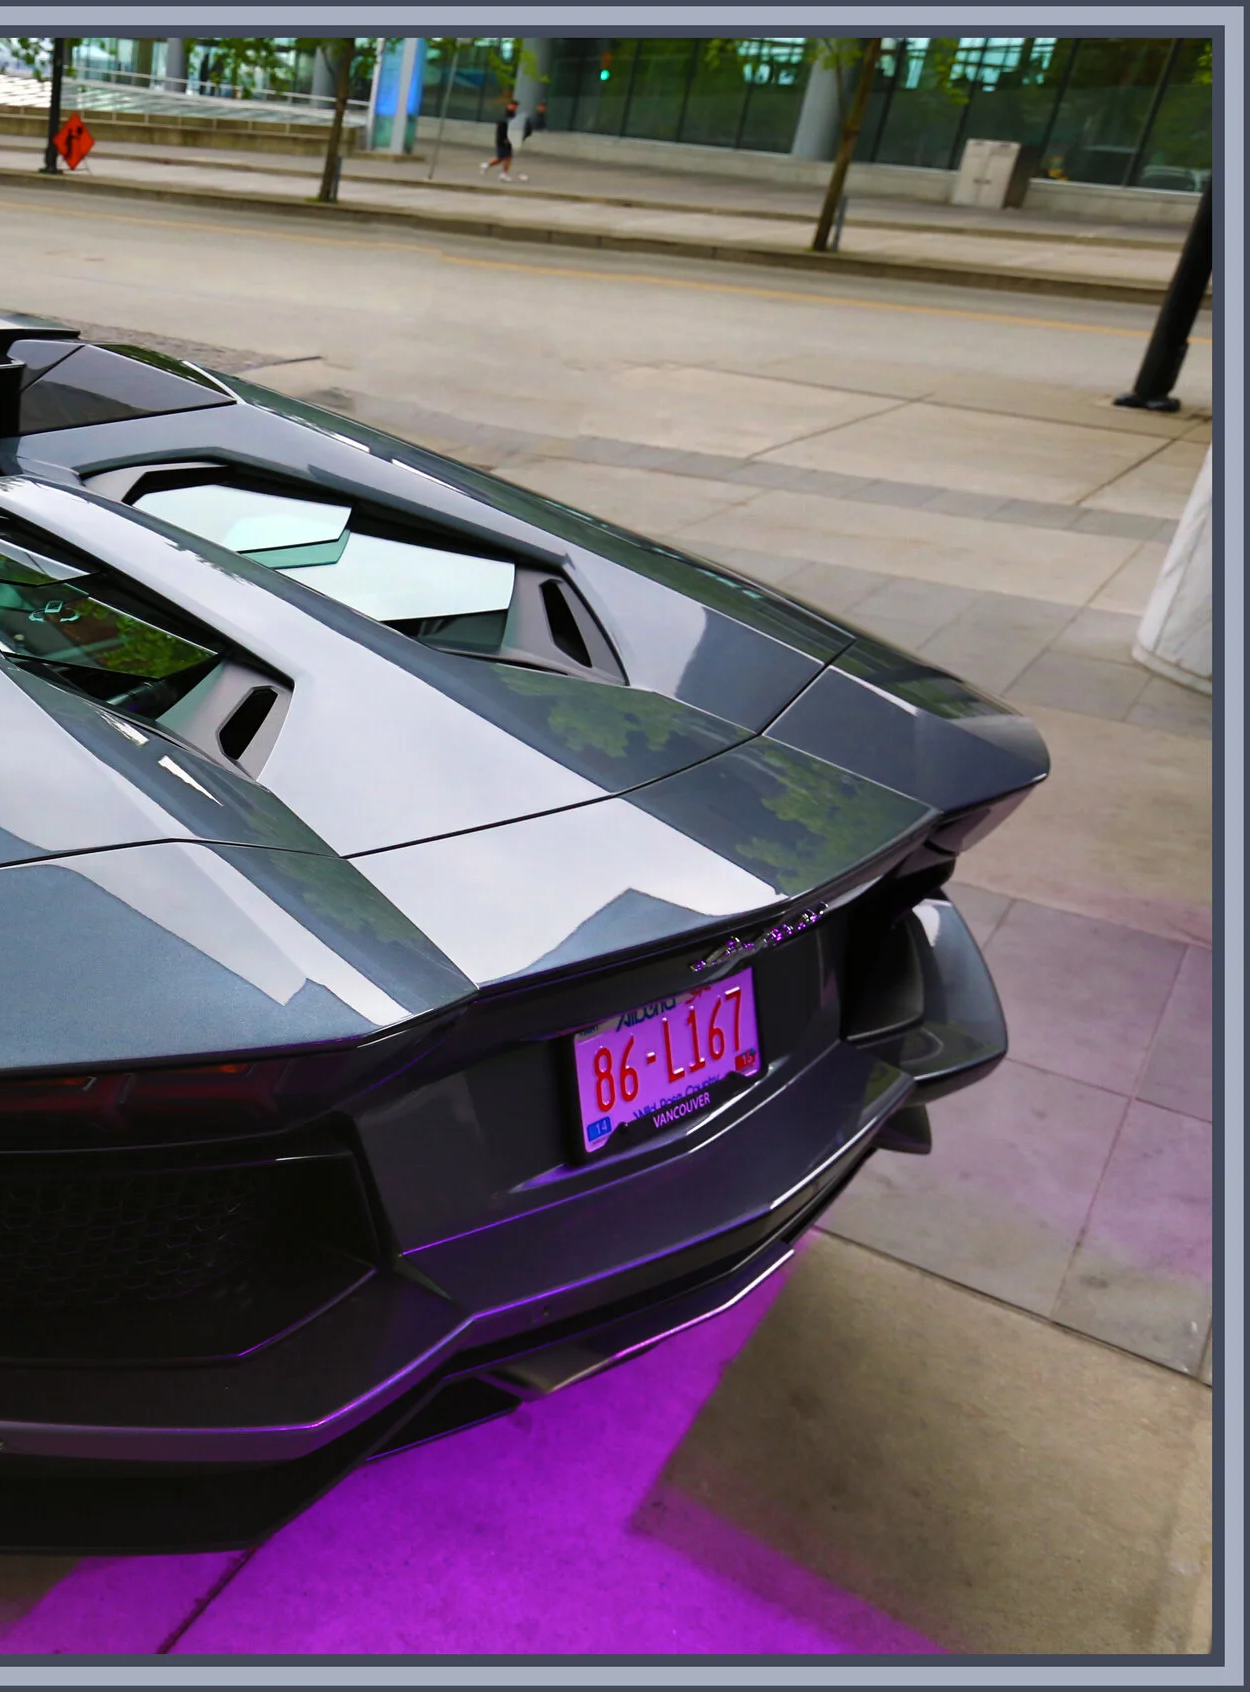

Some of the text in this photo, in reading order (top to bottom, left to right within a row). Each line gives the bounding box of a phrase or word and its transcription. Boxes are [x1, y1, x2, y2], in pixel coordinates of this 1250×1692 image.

[593, 986, 742, 1113] 86-L167
[595, 1119, 608, 1134] 14
[652, 1091, 710, 1128] VANCOUVER
